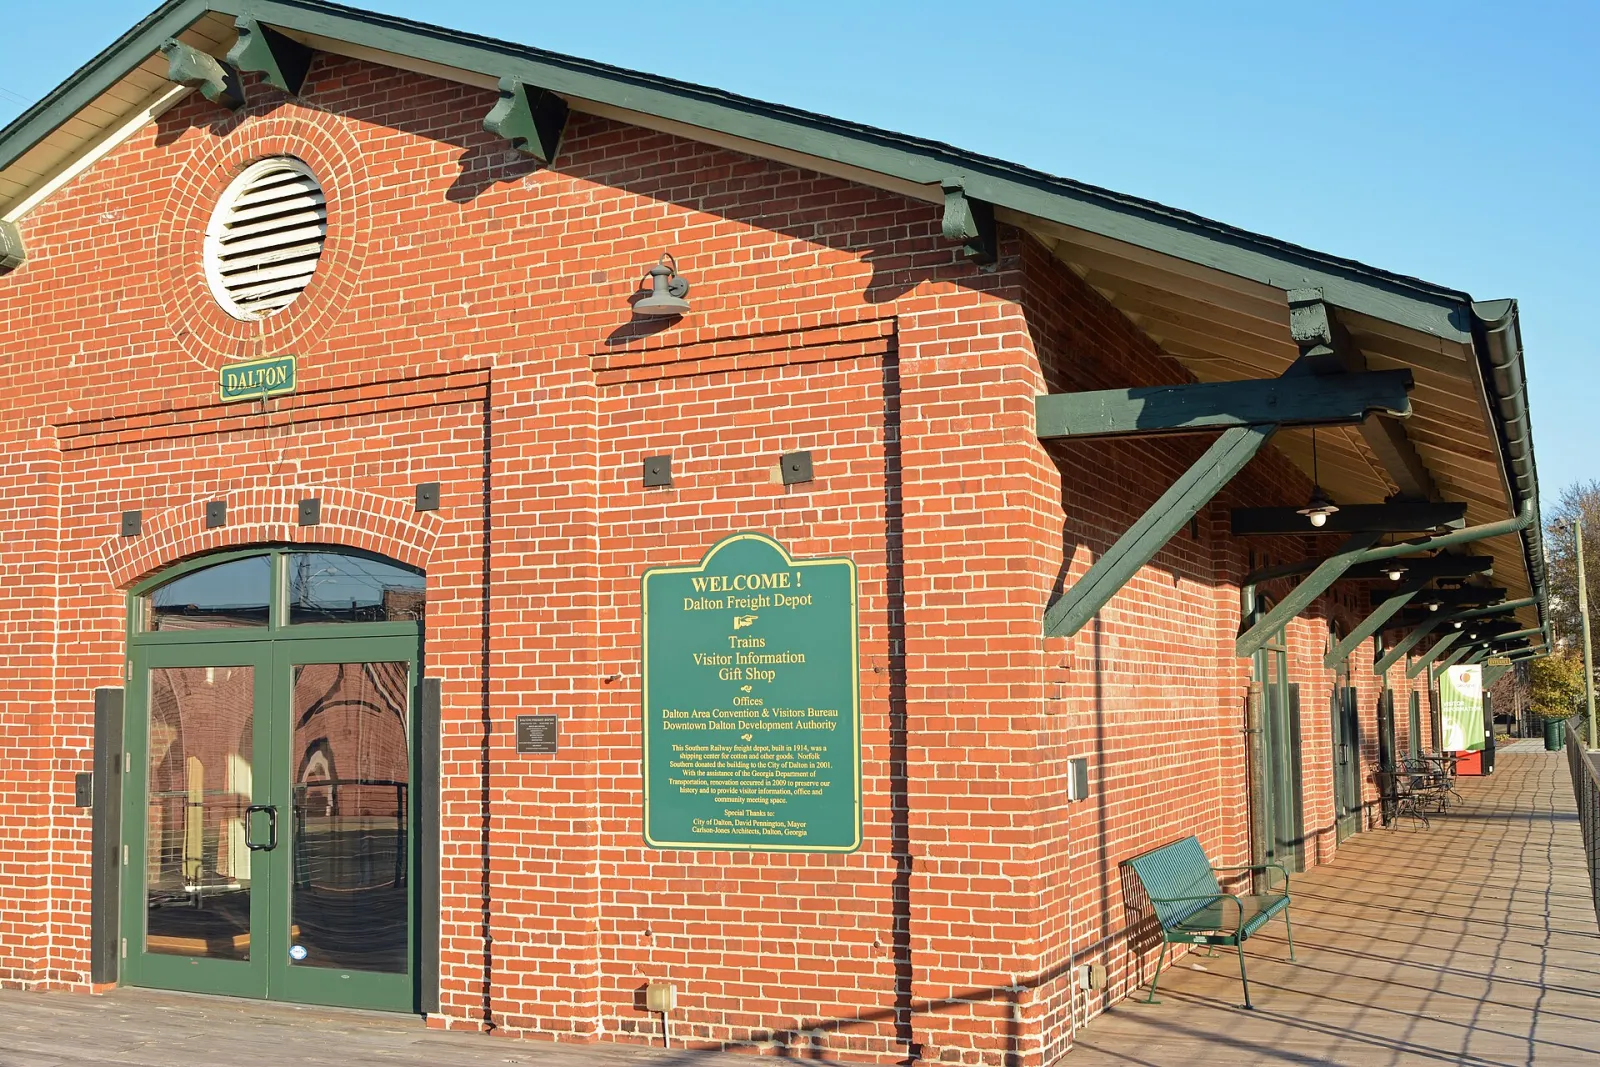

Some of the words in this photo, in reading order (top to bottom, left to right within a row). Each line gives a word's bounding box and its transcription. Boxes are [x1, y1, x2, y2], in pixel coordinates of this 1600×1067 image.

[228, 366, 287, 391] DALTON
[692, 573, 791, 592] WELCOME
[684, 597, 723, 610] Dalton
[727, 595, 770, 610] Freight
[774, 594, 812, 610] Depot
[728, 636, 765, 648] Trains
[693, 653, 732, 665] Visitor
[736, 651, 805, 664] Information
[719, 668, 742, 680] Gift
[746, 667, 775, 682] Shop
[733, 697, 763, 706] Offices
[663, 709, 689, 718] Dalton
[691, 709, 710, 718] Area
[712, 709, 759, 718] Convention
[762, 708, 769, 717] &
[772, 708, 805, 717] Visitors
[808, 708, 838, 717] Bureau
[664, 721, 706, 730] Downtown
[709, 721, 735, 730] Dalton
[738, 720, 793, 731] Development
[796, 720, 836, 731] Authority
[727, 761, 749, 769] building
[752, 770, 774, 778] Georgia
[776, 770, 808, 778] Department
[717, 787, 738, 795] provide
[715, 796, 745, 804] community
[746, 796, 769, 804] meeting
[724, 809, 744, 817] Special
[693, 818, 705, 826] City
[787, 821, 806, 829] Mayor
[784, 829, 807, 837] Georgia
